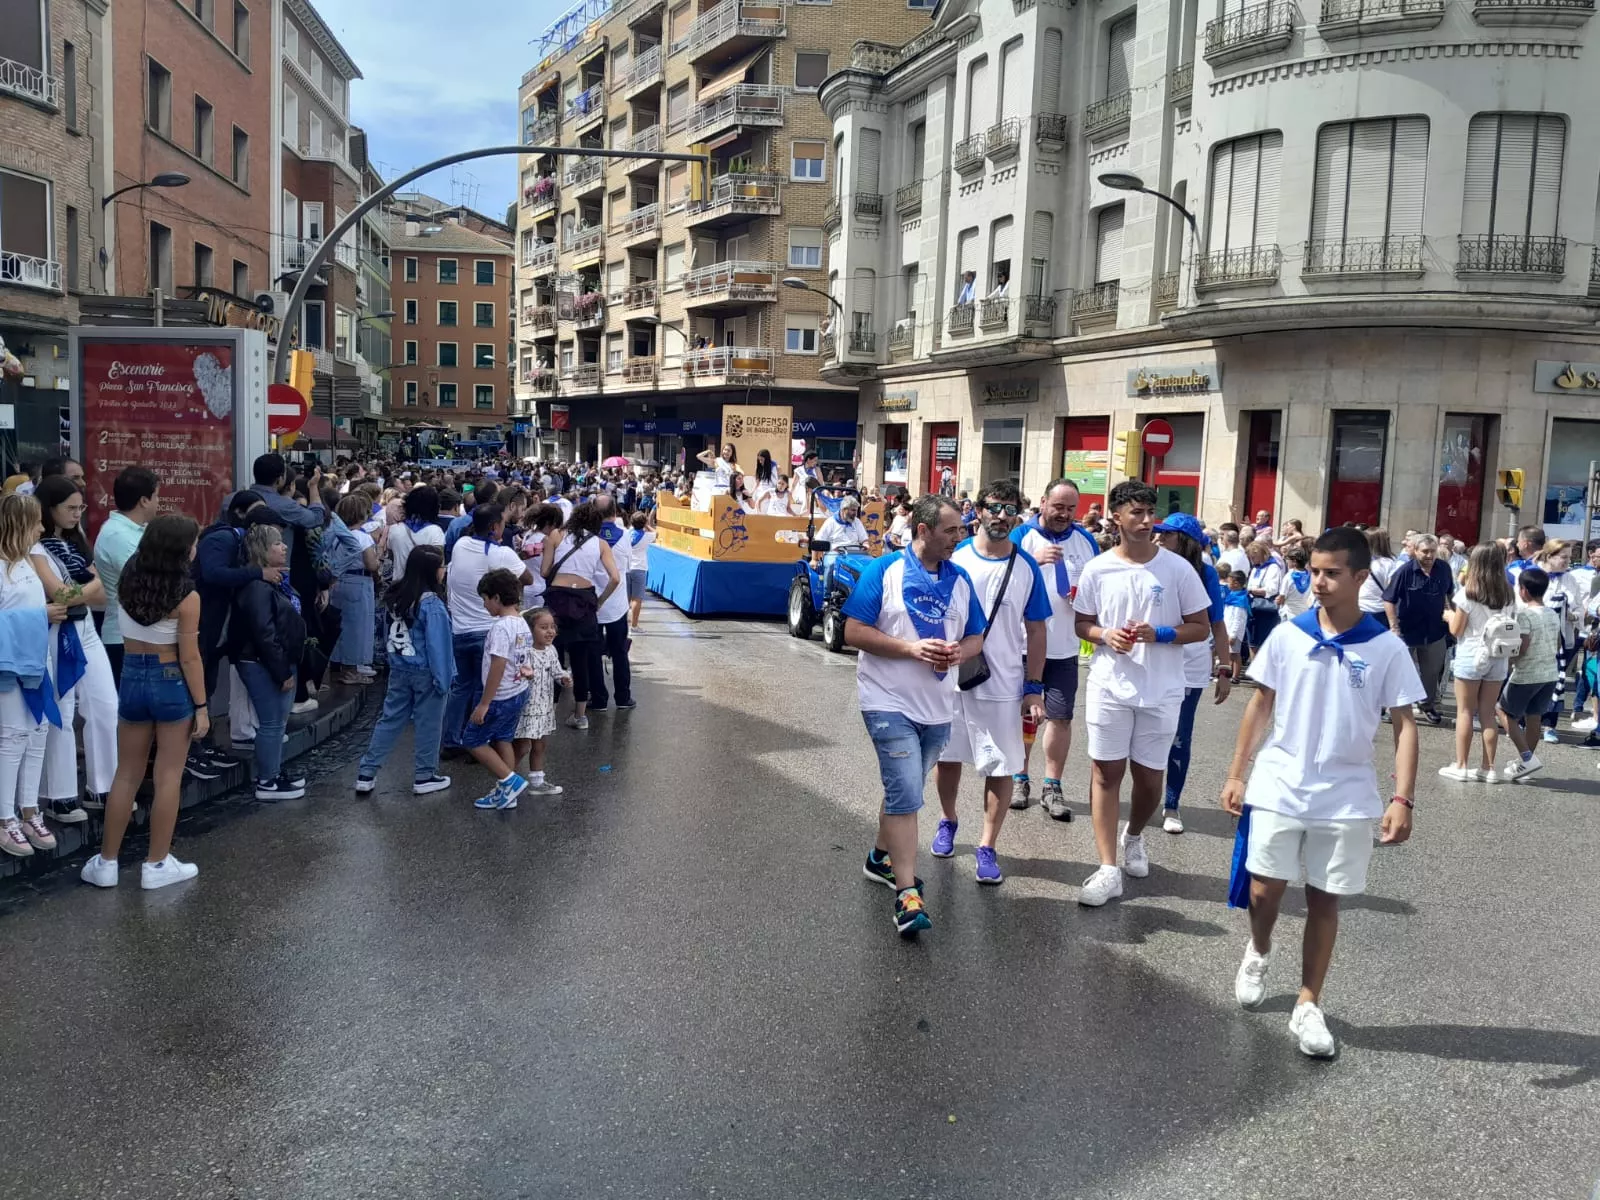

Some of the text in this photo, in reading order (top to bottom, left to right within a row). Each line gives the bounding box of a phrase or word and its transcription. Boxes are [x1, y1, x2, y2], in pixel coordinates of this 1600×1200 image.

[108, 360, 165, 379] Escenario
[1148, 368, 1209, 388] Santander
[125, 380, 143, 394] San
[146, 380, 194, 394] Francisco
[746, 416, 788, 427] DESPENSA
[792, 422, 816, 432] BVA
[99, 430, 108, 444] 2
[142, 441, 155, 449] DOS
[156, 442, 185, 450] ORILLAS
[99, 459, 108, 472] 3
[98, 493, 108, 507] 4
